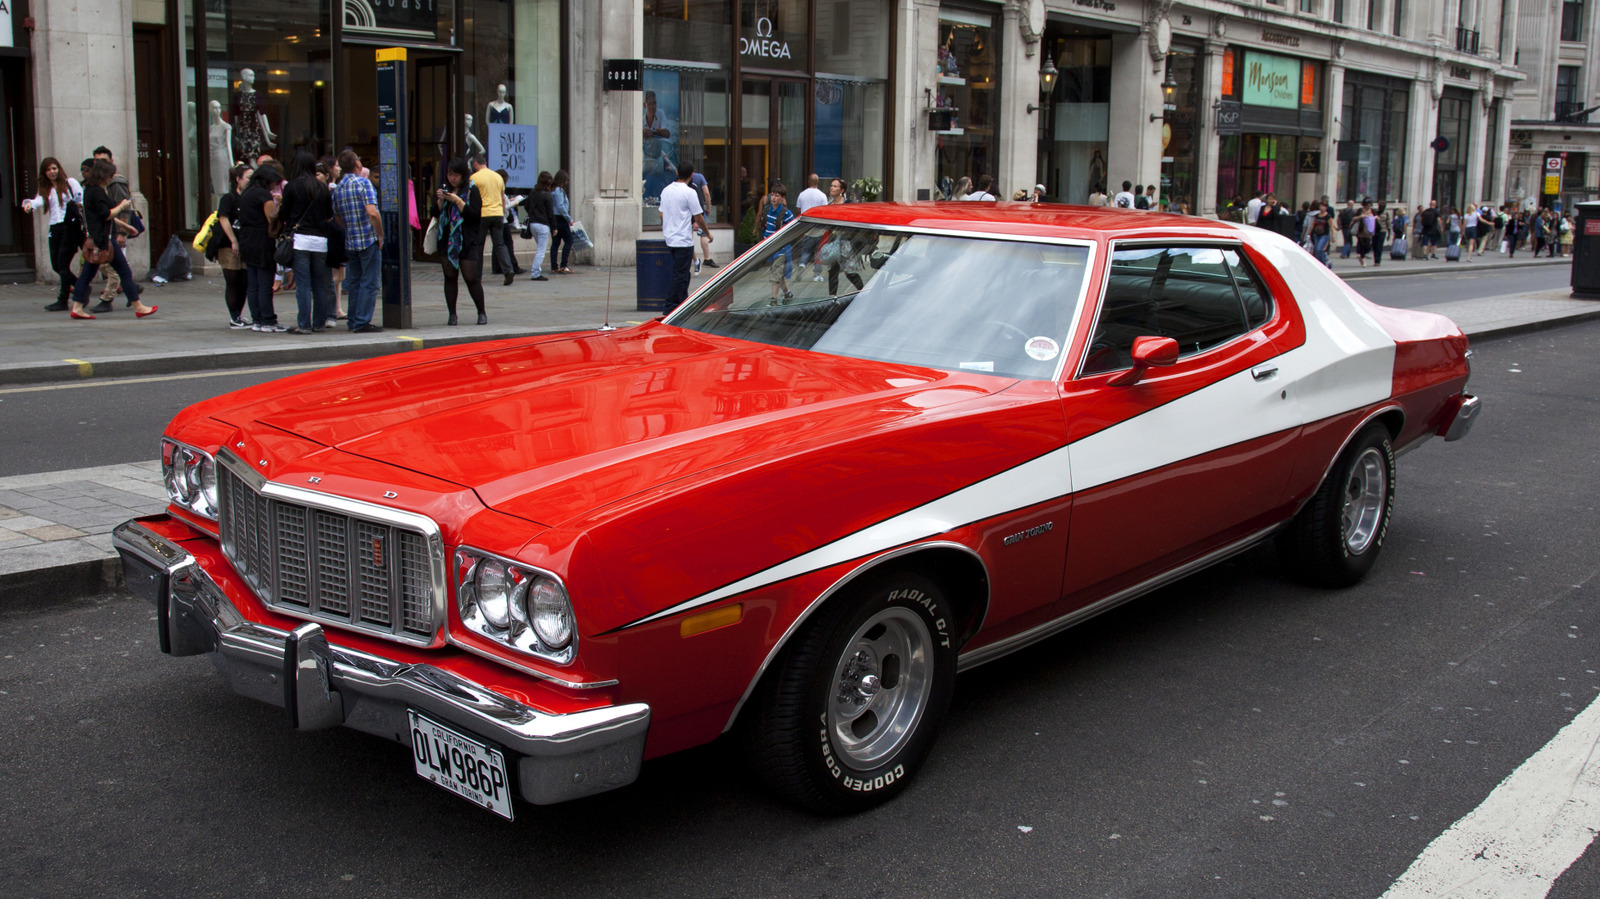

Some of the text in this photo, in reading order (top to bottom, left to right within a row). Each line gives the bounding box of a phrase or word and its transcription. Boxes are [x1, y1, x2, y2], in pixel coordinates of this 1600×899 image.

[740, 37, 791, 59] OMEGA
[608, 70, 638, 80] coast
[1248, 61, 1288, 93] Monsoon
[500, 131, 526, 144] SALE
[1003, 521, 1053, 547] GRAN TORINO
[887, 588, 950, 648] RADIAL G/T
[432, 727, 477, 756] CALIFORNIA
[820, 711, 905, 792] COOPER COBRA
[440, 775, 484, 804] GRAN TORINO
